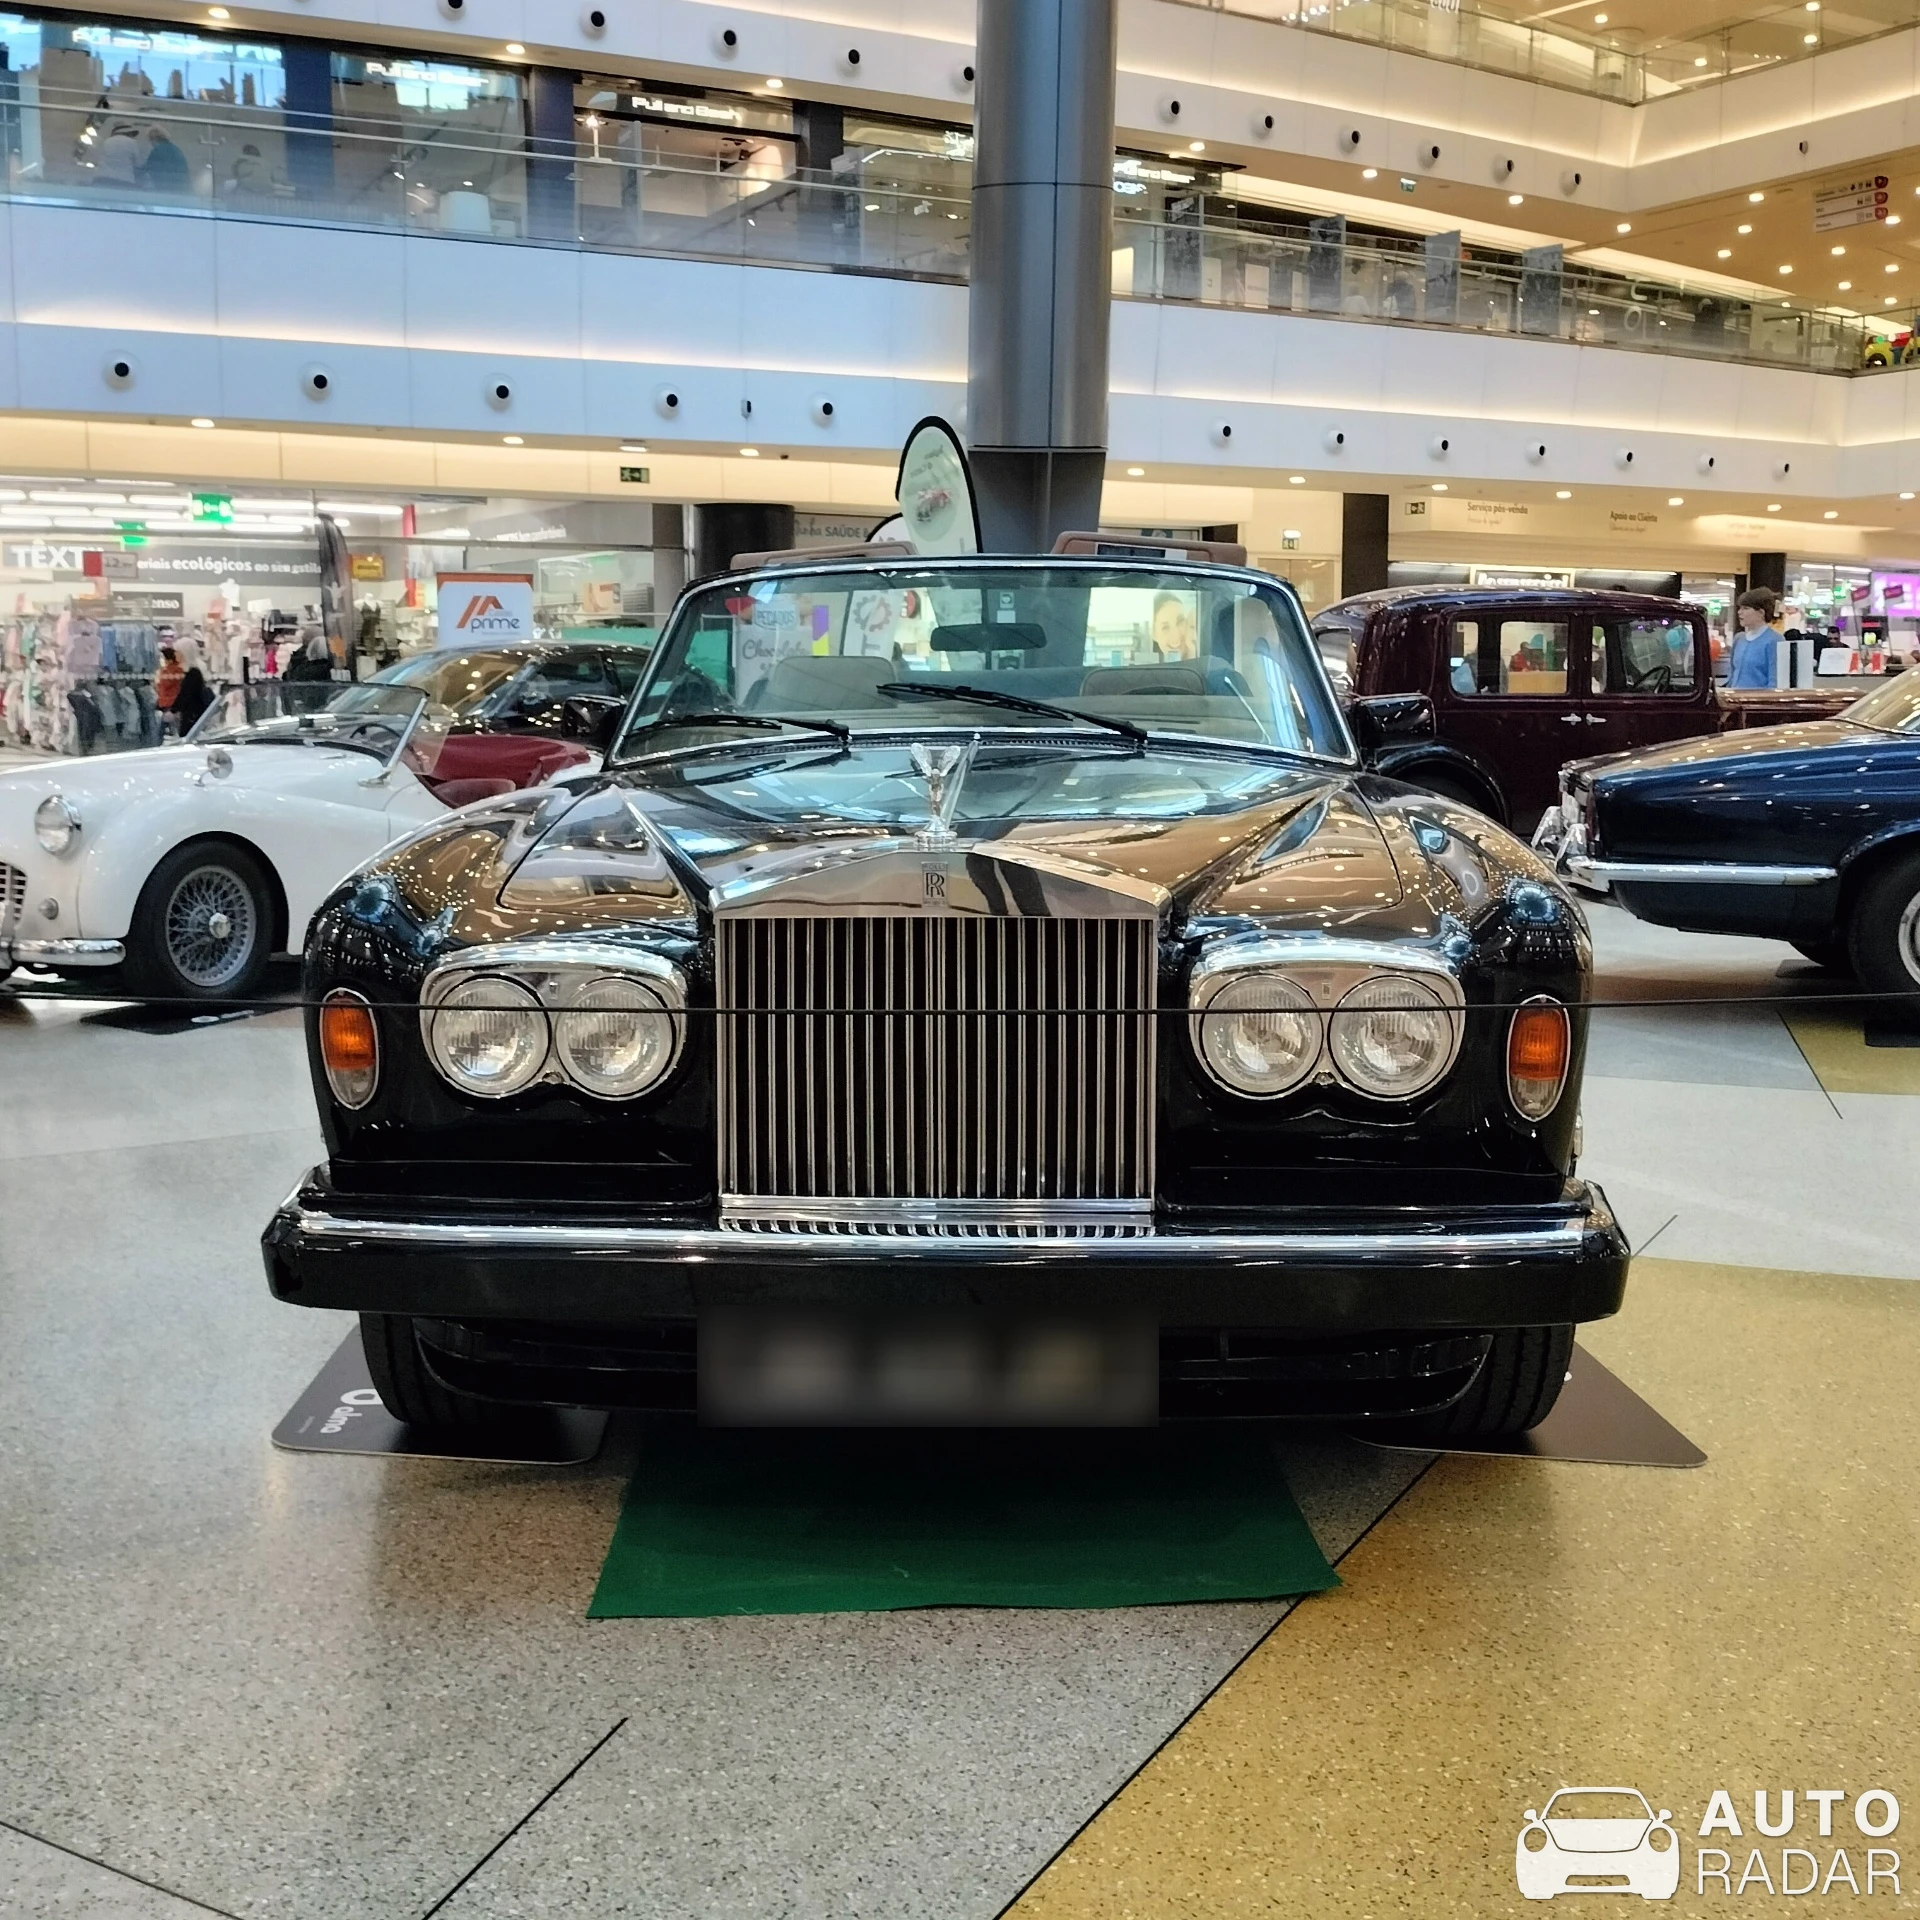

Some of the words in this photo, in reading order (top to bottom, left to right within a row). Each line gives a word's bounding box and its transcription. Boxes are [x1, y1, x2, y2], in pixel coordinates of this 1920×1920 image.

[632, 96, 663, 111] Pull
[1467, 501, 1492, 514] Serviço
[1610, 511, 1628, 521] Apoio
[825, 524, 861, 538] SAÚDE
[11, 538, 104, 569] TÊXT
[172, 556, 253, 574] ecológicos
[254, 562, 270, 572] ao
[470, 617, 520, 633] prime
